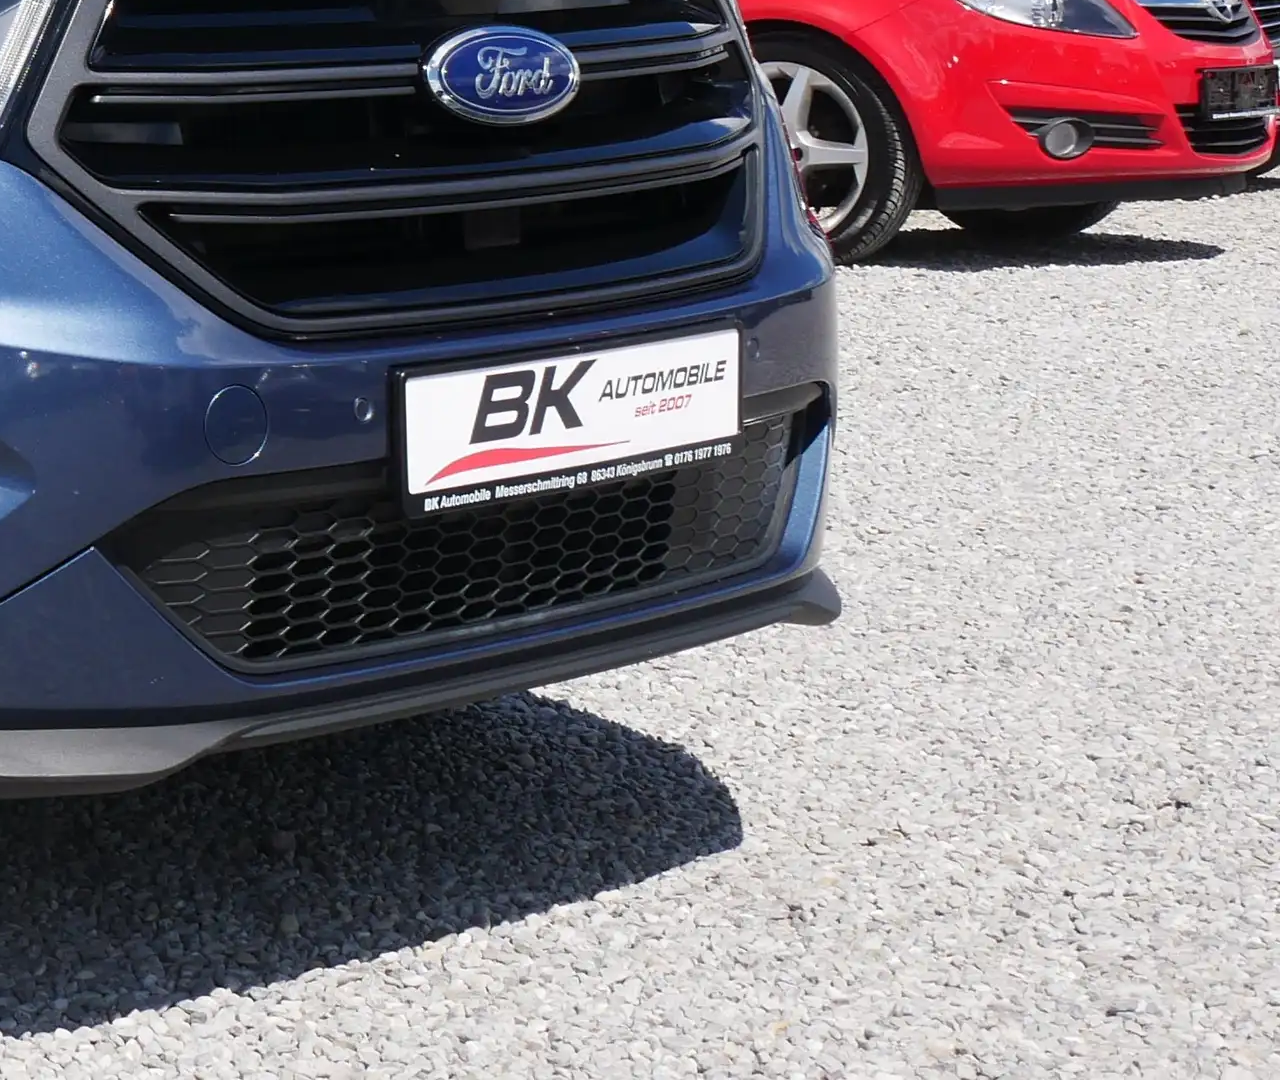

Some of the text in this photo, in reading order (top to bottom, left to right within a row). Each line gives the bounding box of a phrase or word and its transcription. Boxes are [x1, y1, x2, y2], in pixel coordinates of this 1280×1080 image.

[475, 46, 553, 100] Ford
[469, 359, 728, 446] BK AUTOMOBILE
[634, 393, 693, 419] seit 2007
[424, 496, 440, 512] BK
[440, 488, 491, 510] Automobile
[495, 474, 575, 499] Messerschmittring
[616, 456, 663, 478] Königsbrunn
[674, 450, 693, 465] 0176
[694, 446, 712, 461] 1977
[713, 442, 732, 457] 1976
